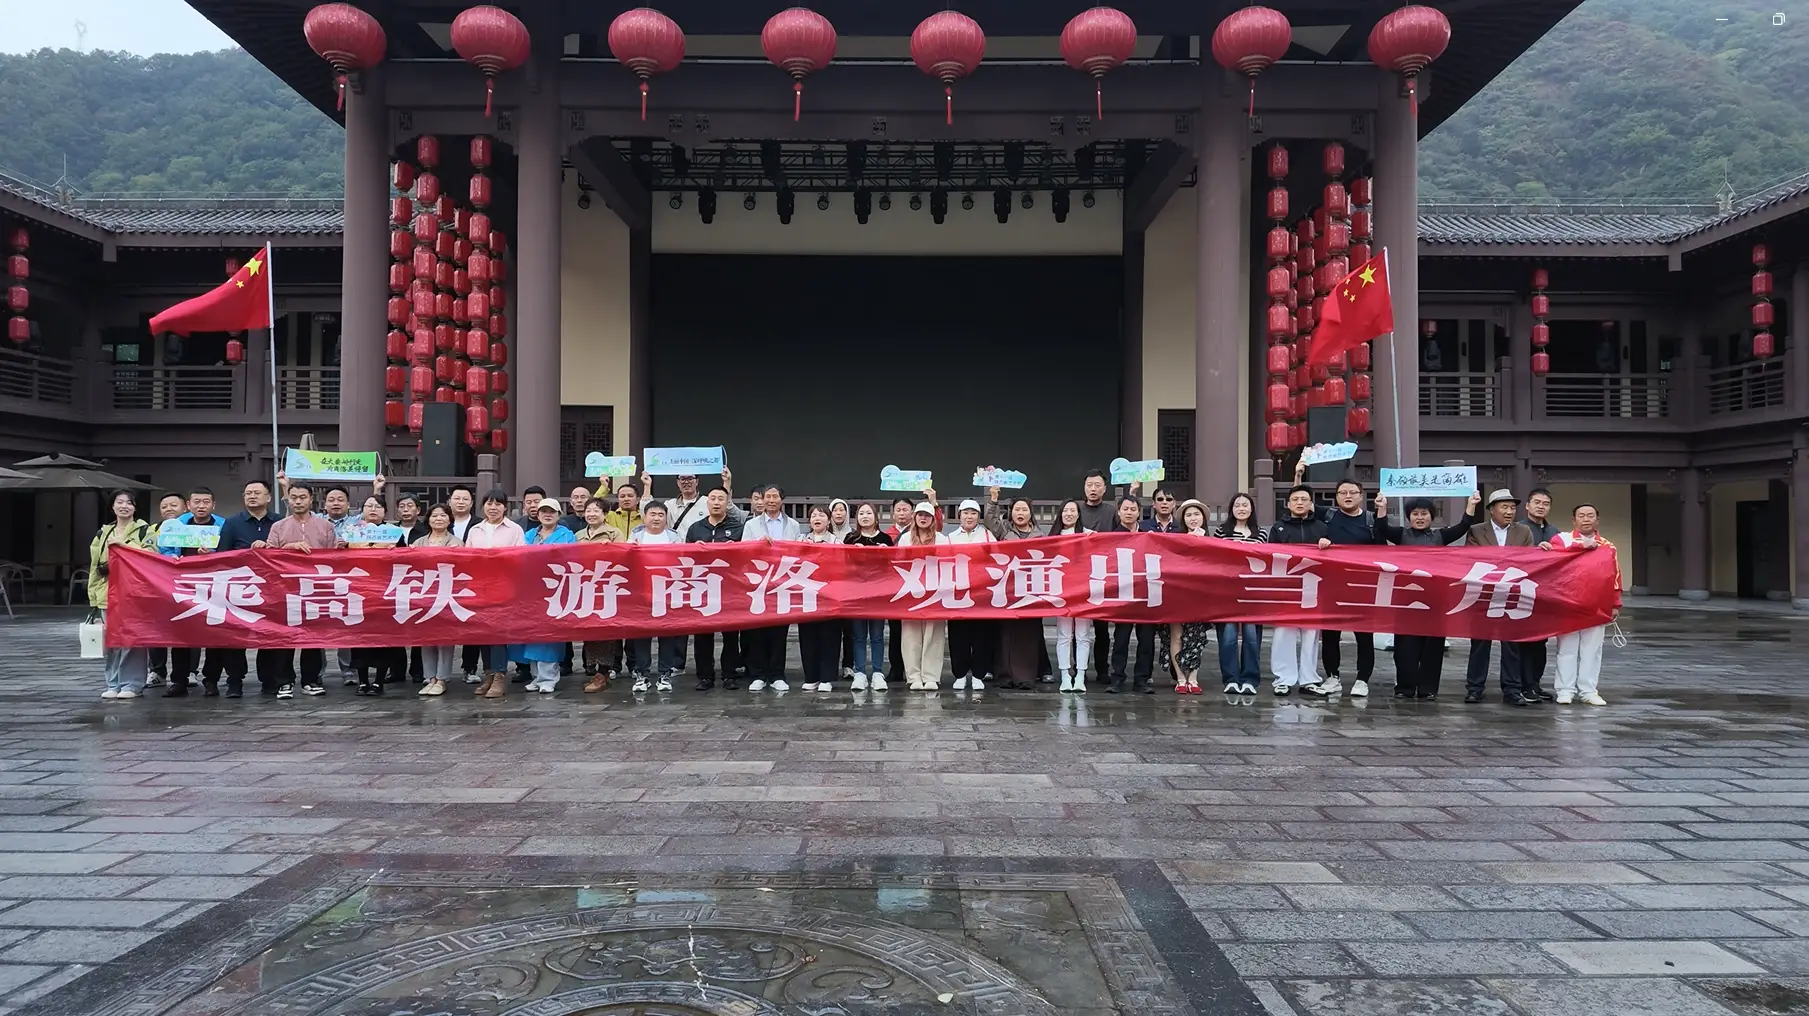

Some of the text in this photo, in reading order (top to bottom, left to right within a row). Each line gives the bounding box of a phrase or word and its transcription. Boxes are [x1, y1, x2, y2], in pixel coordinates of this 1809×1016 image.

[171, 547, 1540, 627] 乘高铁 游商洛 观演出 当主角
